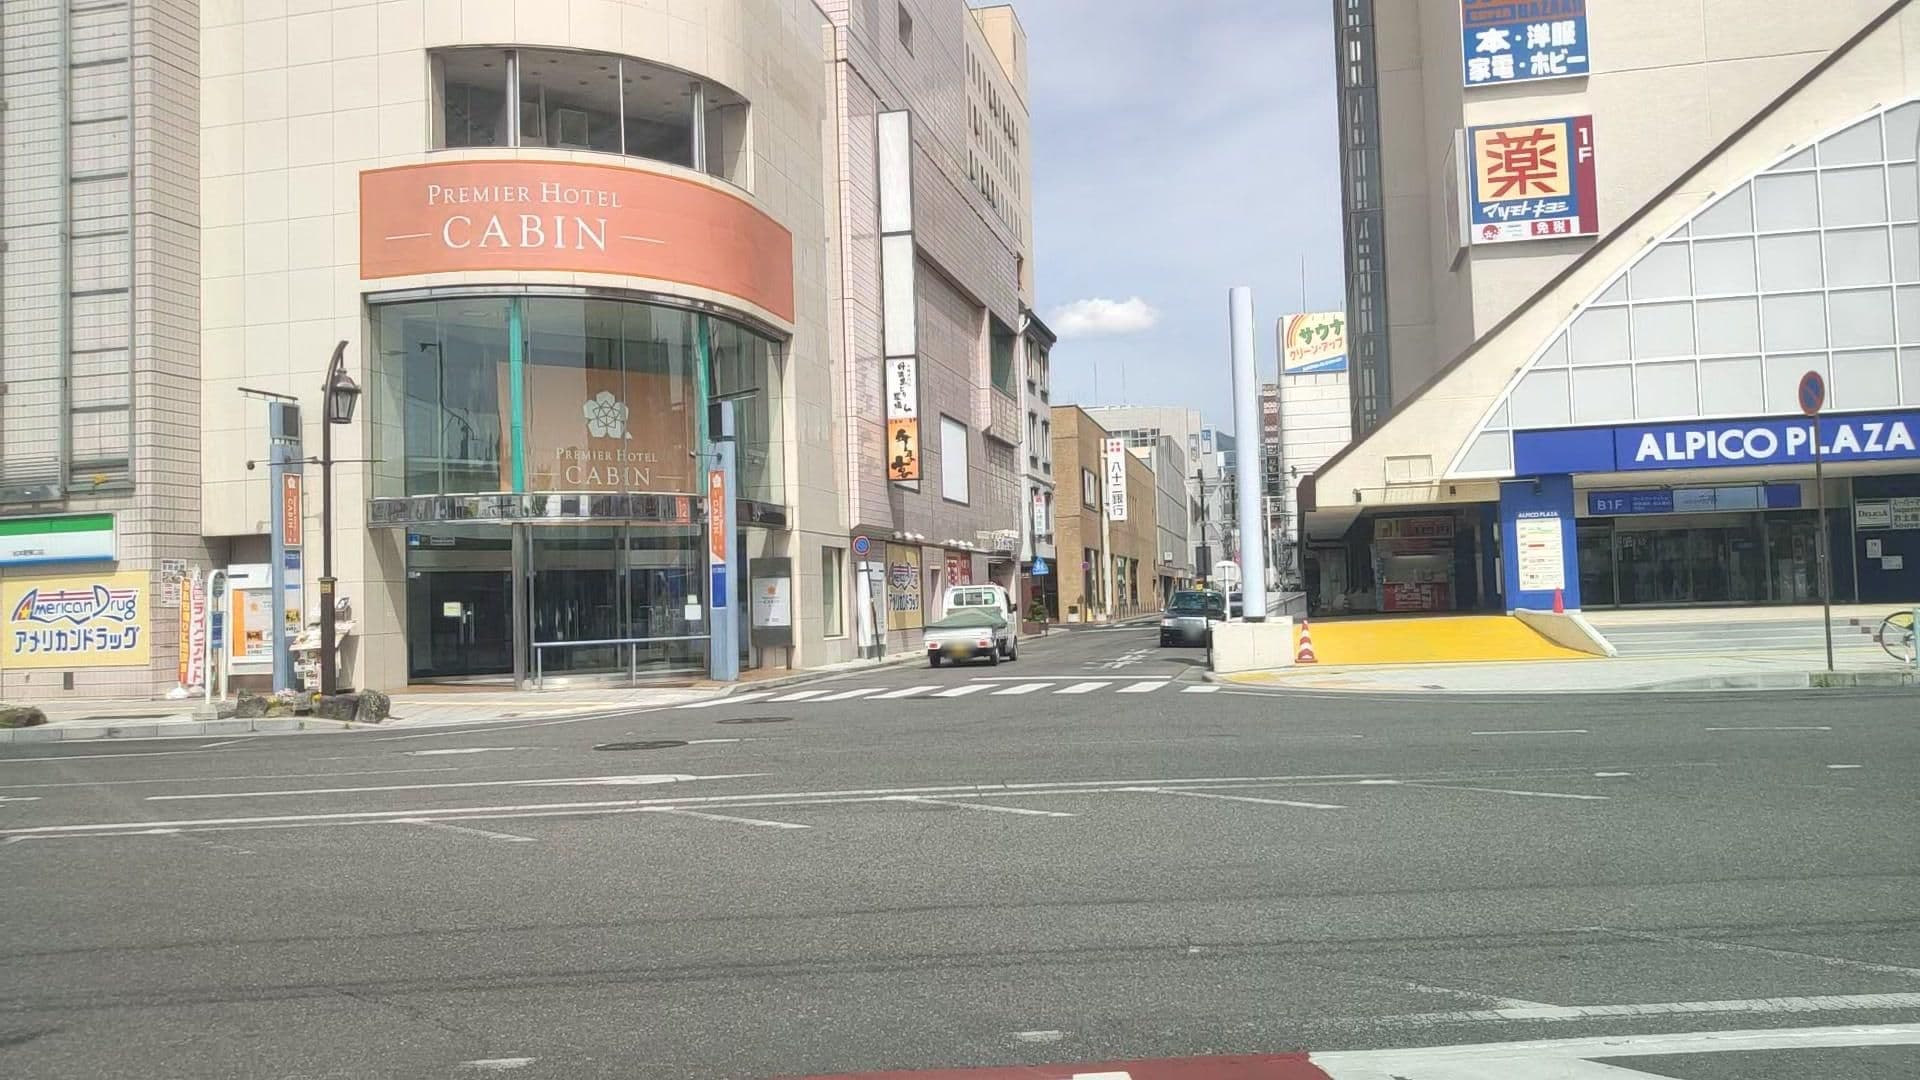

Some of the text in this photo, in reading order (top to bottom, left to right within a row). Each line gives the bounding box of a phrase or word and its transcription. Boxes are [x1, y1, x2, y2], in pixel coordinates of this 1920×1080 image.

[1475, 20, 1577, 53] 本・洋服
[1468, 47, 1586, 81] 家電・ホビー
[1578, 127, 1592, 163] 1F
[1485, 128, 1558, 198] 薬
[428, 183, 622, 208] PREMIER HOTEL
[1483, 199, 1569, 221] マツモトキヨシ
[443, 215, 607, 250] CABIN
[1536, 220, 1566, 234] 免税
[1299, 318, 1344, 345] サウナ
[1635, 422, 1916, 461] ALPICO PLAZA
[565, 465, 651, 486] CABIN
[1111, 461, 1123, 516] 八十二銀行
[1597, 499, 1624, 511] B1F
[12, 585, 138, 622] American Drug
[15, 626, 140, 653] アメリカンドラッグ
